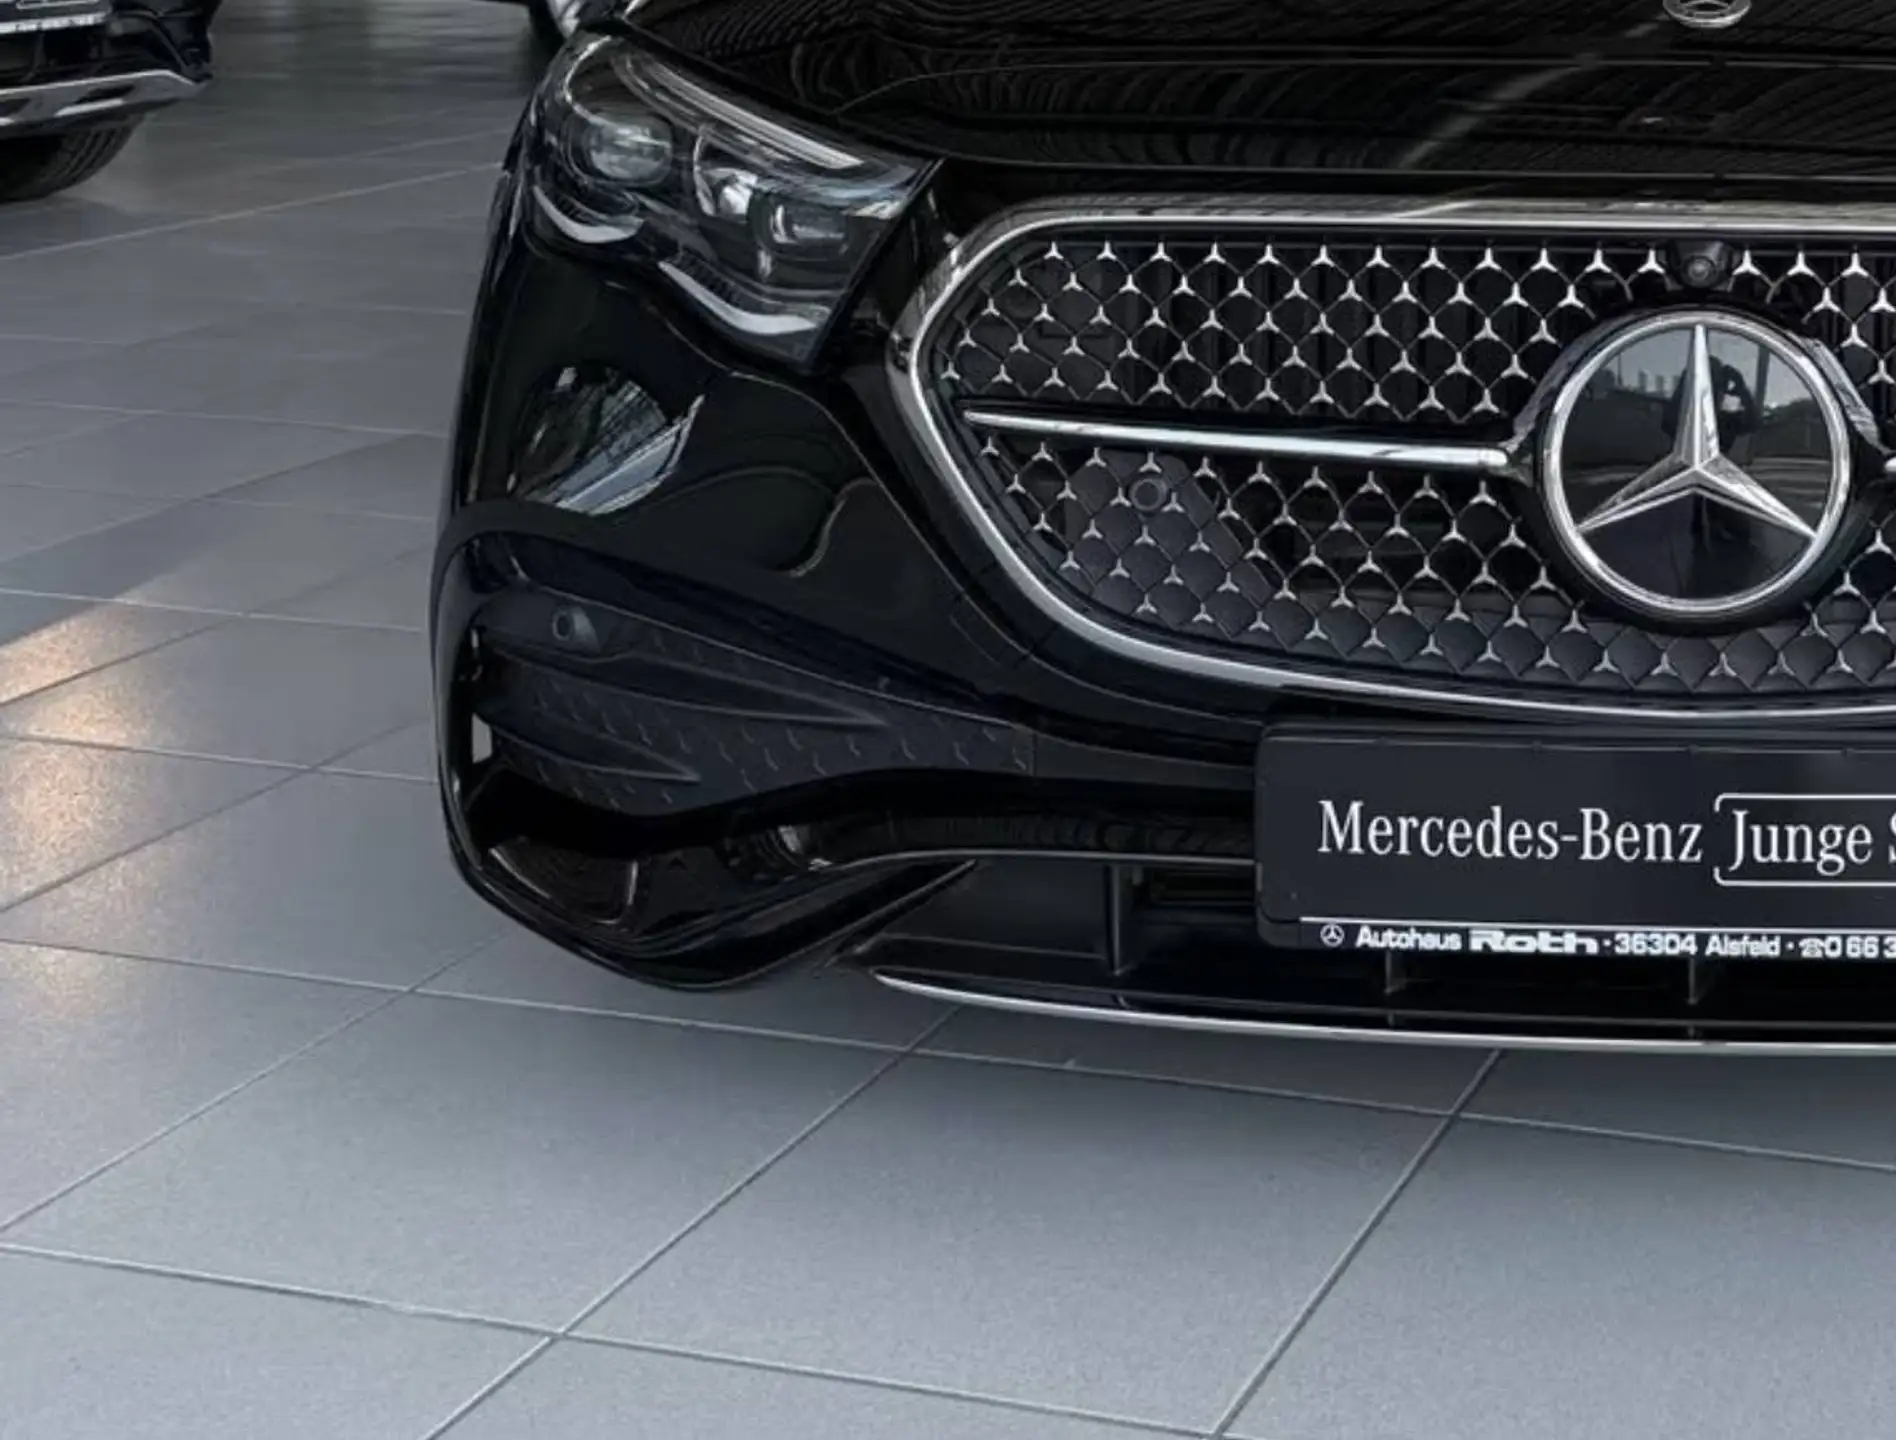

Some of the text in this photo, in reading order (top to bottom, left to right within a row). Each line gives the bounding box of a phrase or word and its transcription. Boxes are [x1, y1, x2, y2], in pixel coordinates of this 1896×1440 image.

[1317, 799, 1703, 863] Mercedes-Benz
[1728, 809, 1873, 877] Junge
[1355, 925, 1462, 951] Autohaus
[1469, 929, 1599, 954] Roth
[1614, 932, 1698, 956] 36304
[1705, 934, 1781, 957] Alsfeld
